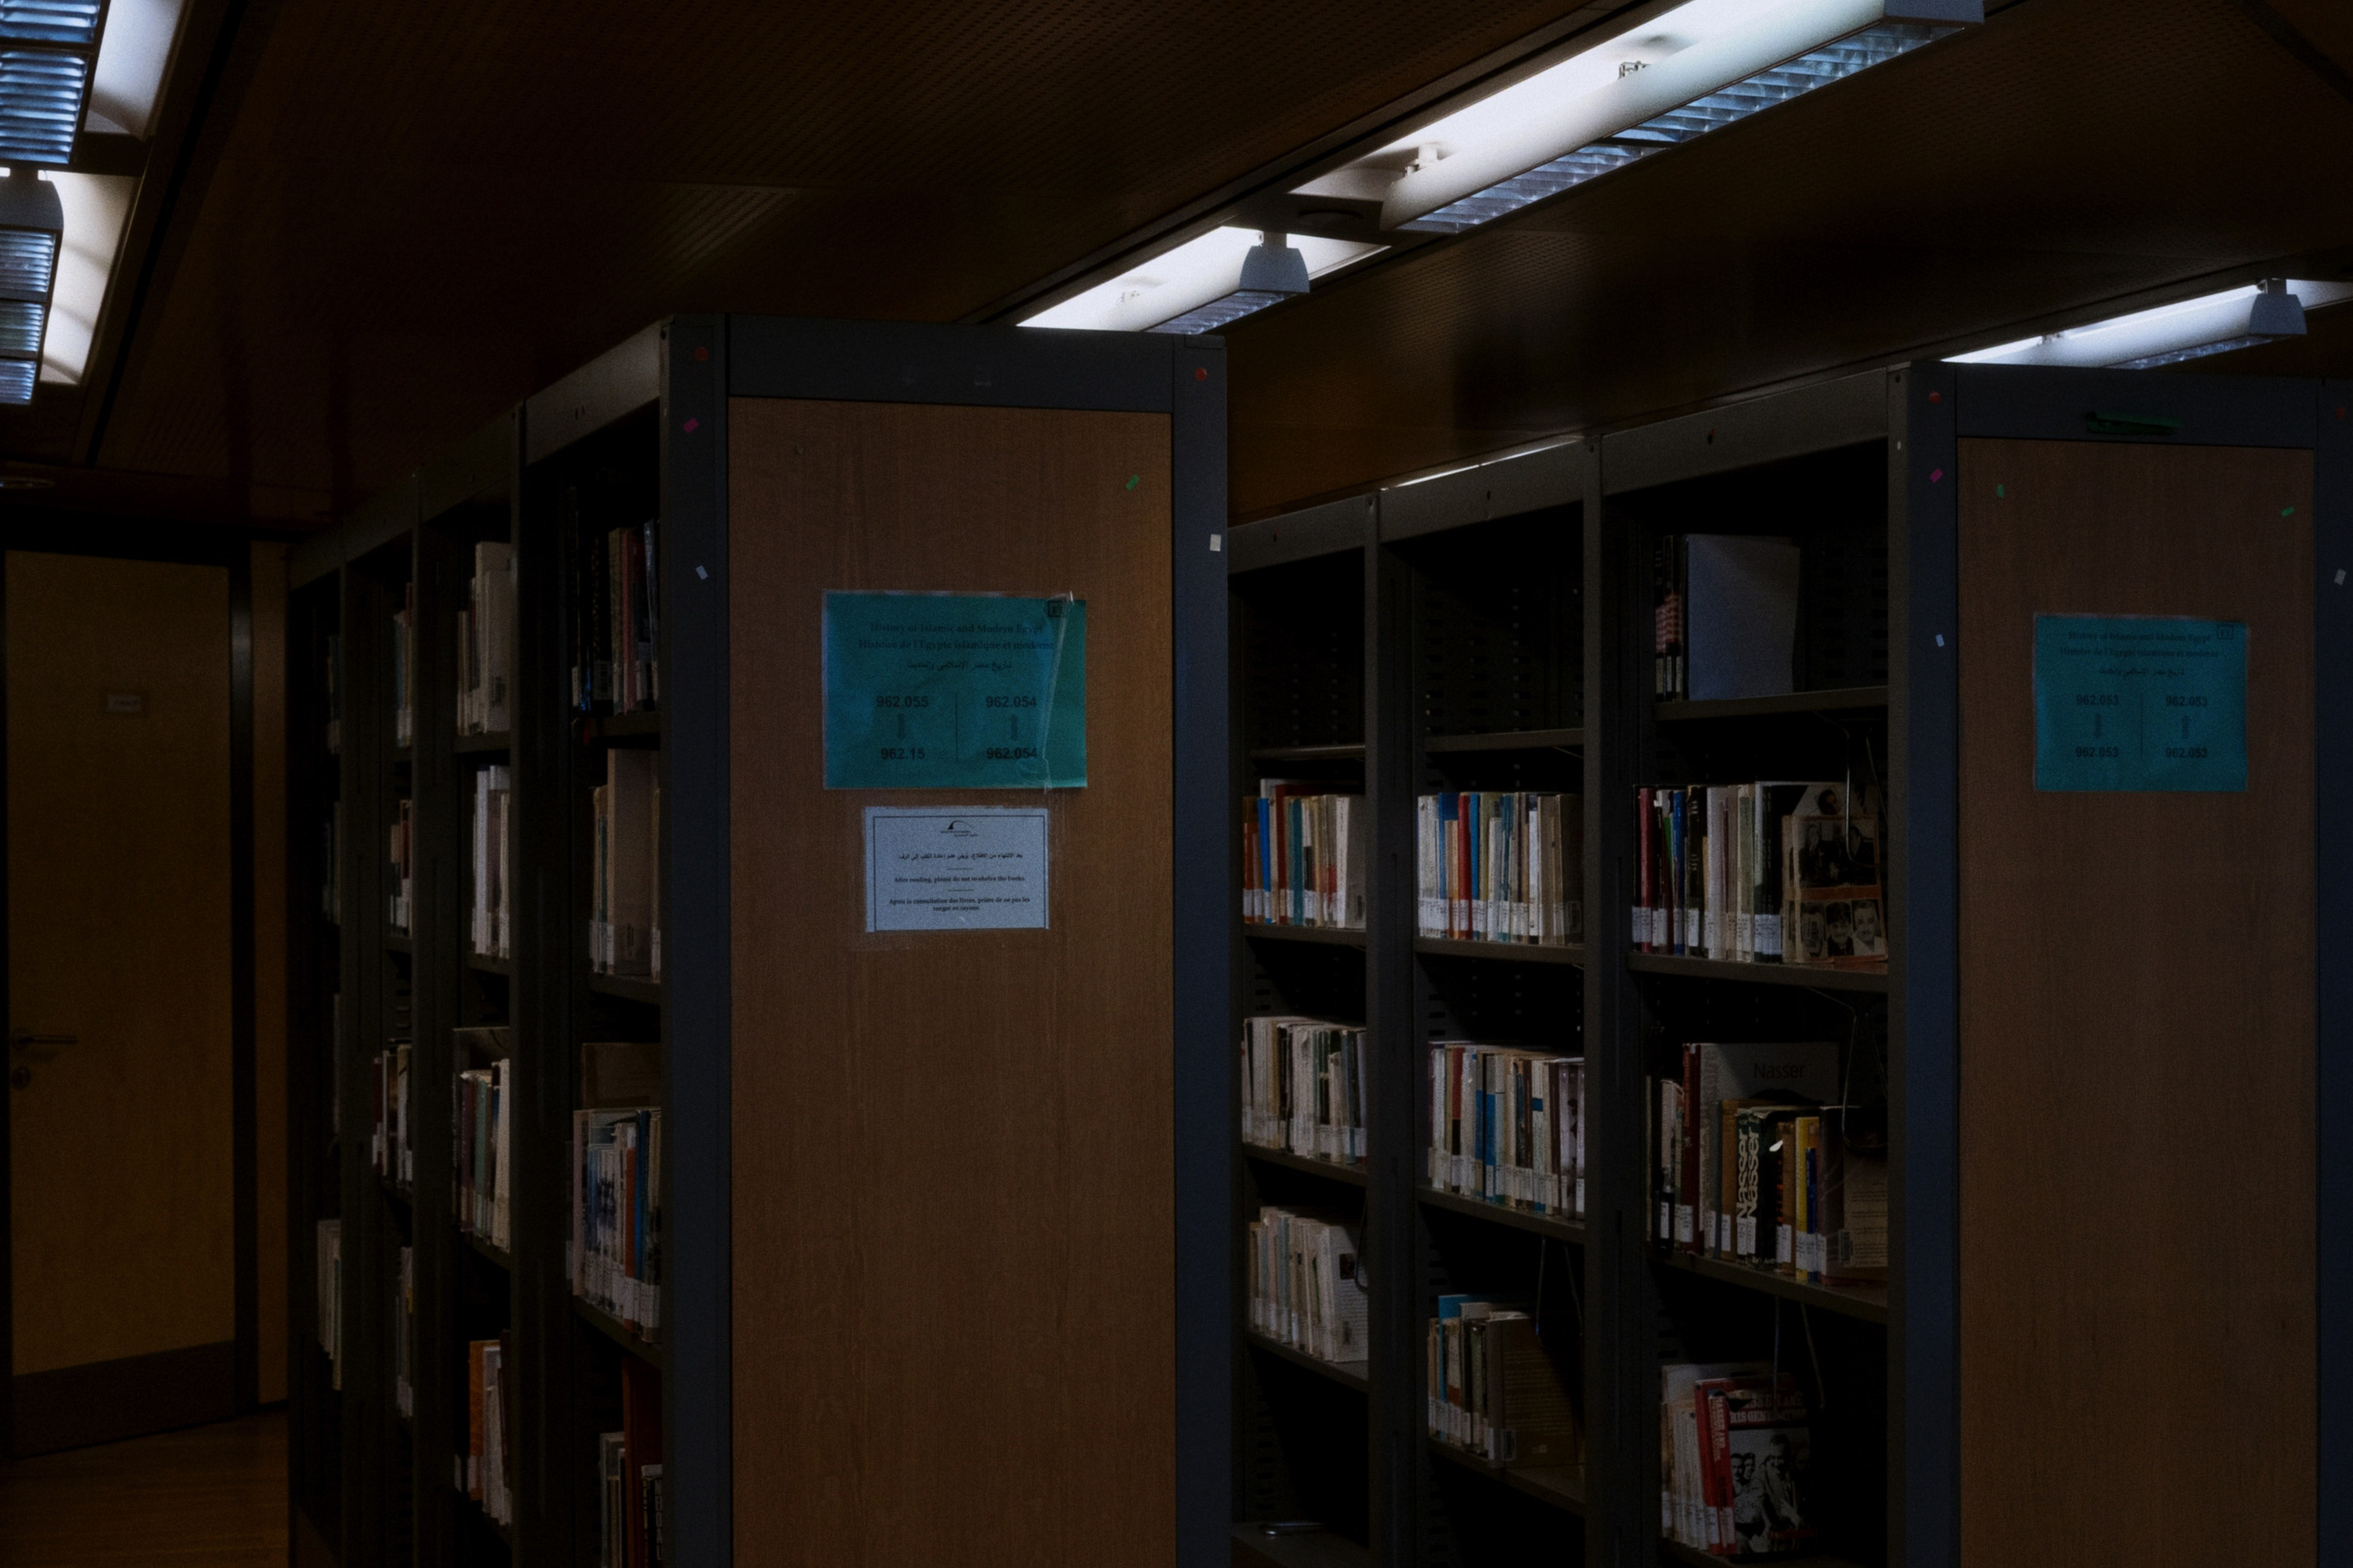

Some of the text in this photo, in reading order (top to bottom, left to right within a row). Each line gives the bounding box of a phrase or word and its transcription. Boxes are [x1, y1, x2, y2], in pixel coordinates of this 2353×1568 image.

[920, 623, 954, 632] Islamic
[957, 623, 974, 633] and
[977, 624, 1014, 633] Modern
[900, 640, 912, 649] de
[954, 640, 1000, 651] islamique
[1003, 641, 1011, 649] et
[876, 695, 929, 709] 962.055
[985, 695, 1037, 709] 962.054
[2076, 694, 2120, 706] 962.053
[2165, 695, 2208, 707] 962.053
[881, 746, 926, 760] 962.15
[985, 746, 1038, 760] 962.054
[2075, 746, 2119, 758] 962.053
[2165, 746, 2208, 759] 962.053
[1753, 1062, 1806, 1079] Nasser
[1736, 1128, 1748, 1219] Nasser
[1747, 1126, 1759, 1218] Nasser
